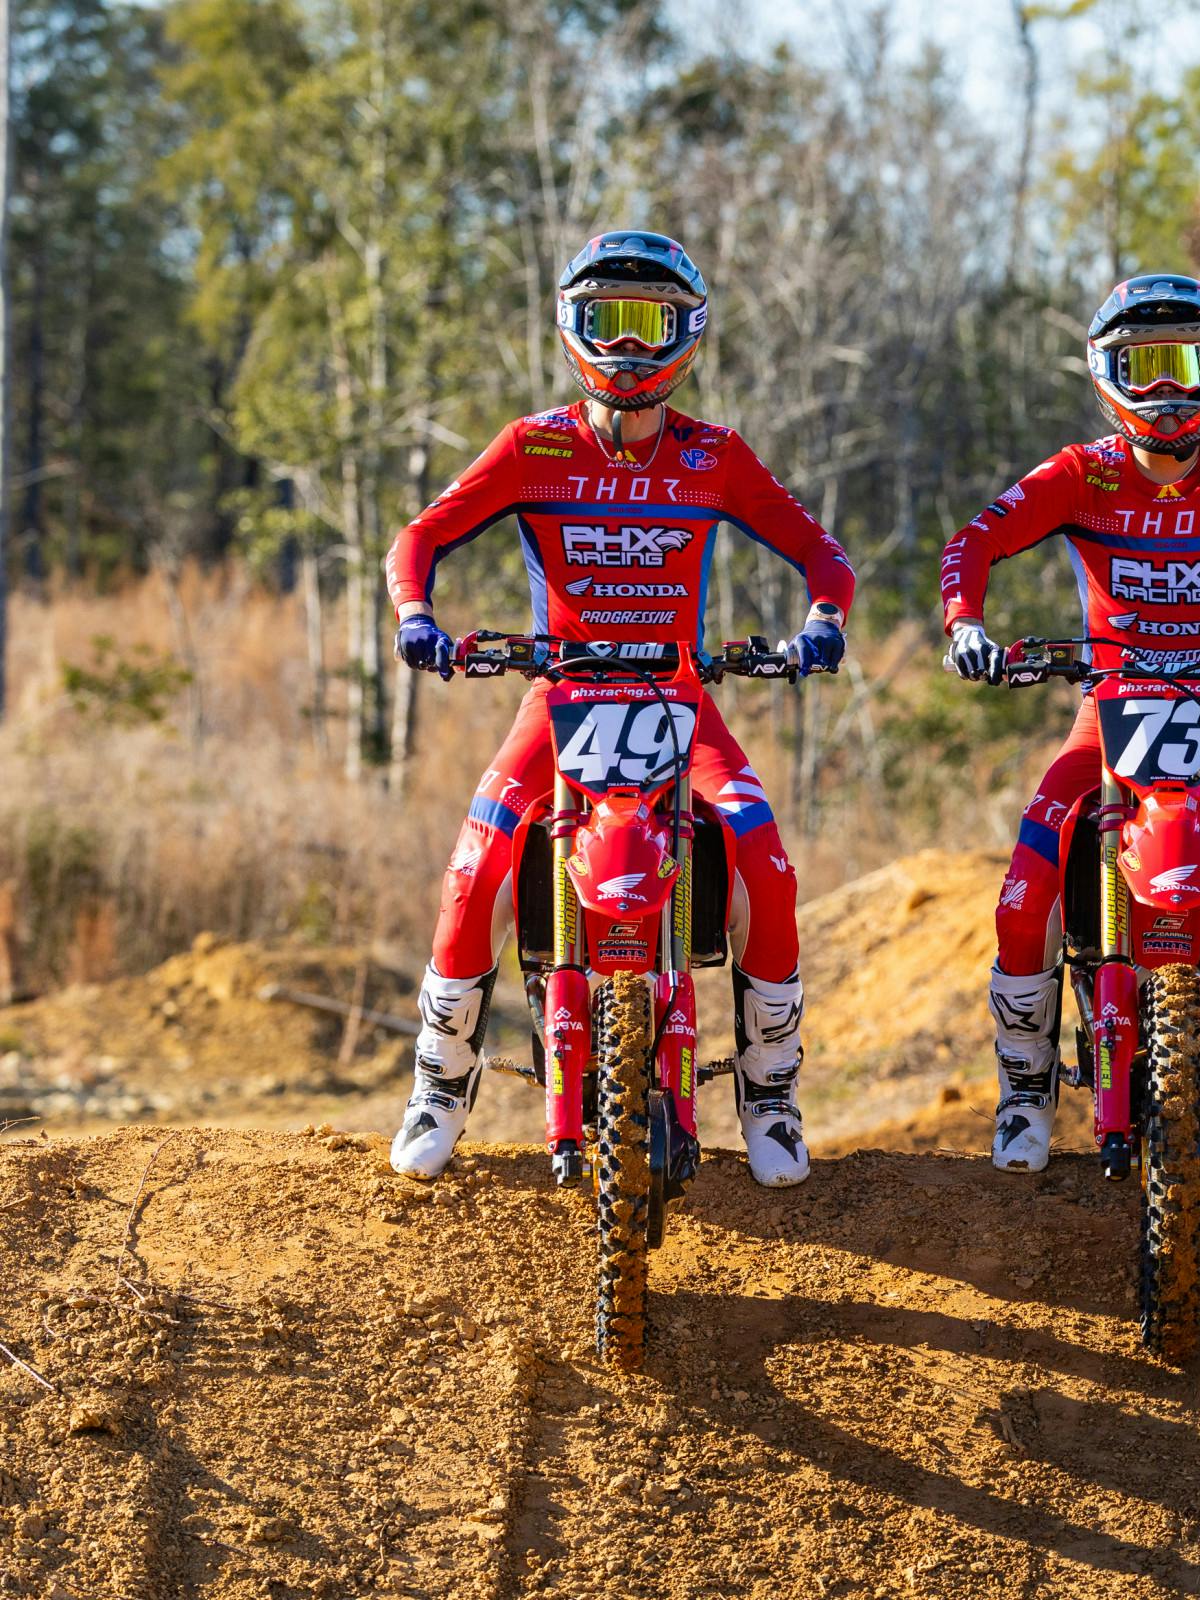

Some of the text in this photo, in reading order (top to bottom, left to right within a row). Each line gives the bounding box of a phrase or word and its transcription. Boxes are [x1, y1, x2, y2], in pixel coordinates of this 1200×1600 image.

[524, 446, 573, 458] TAMER
[568, 476, 680, 502] THOR
[562, 526, 665, 552] PHX
[592, 584, 689, 597] HONDA
[580, 610, 677, 624] PROGRESSIVE
[467, 663, 500, 674] ASV
[753, 663, 786, 674] ASV
[1010, 671, 1043, 683] ASV
[558, 702, 696, 783] 49
[1150, 884, 1200, 894] HONDA
[597, 892, 648, 902] HONDA
[1106, 847, 1117, 945] Connection
[566, 872, 577, 945] actory
[1117, 871, 1128, 936] actory
[1143, 941, 1191, 951] PARTS
[599, 948, 646, 958] PARTS
[662, 1024, 696, 1036] UBYA
[680, 1047, 692, 1098] TAMER
